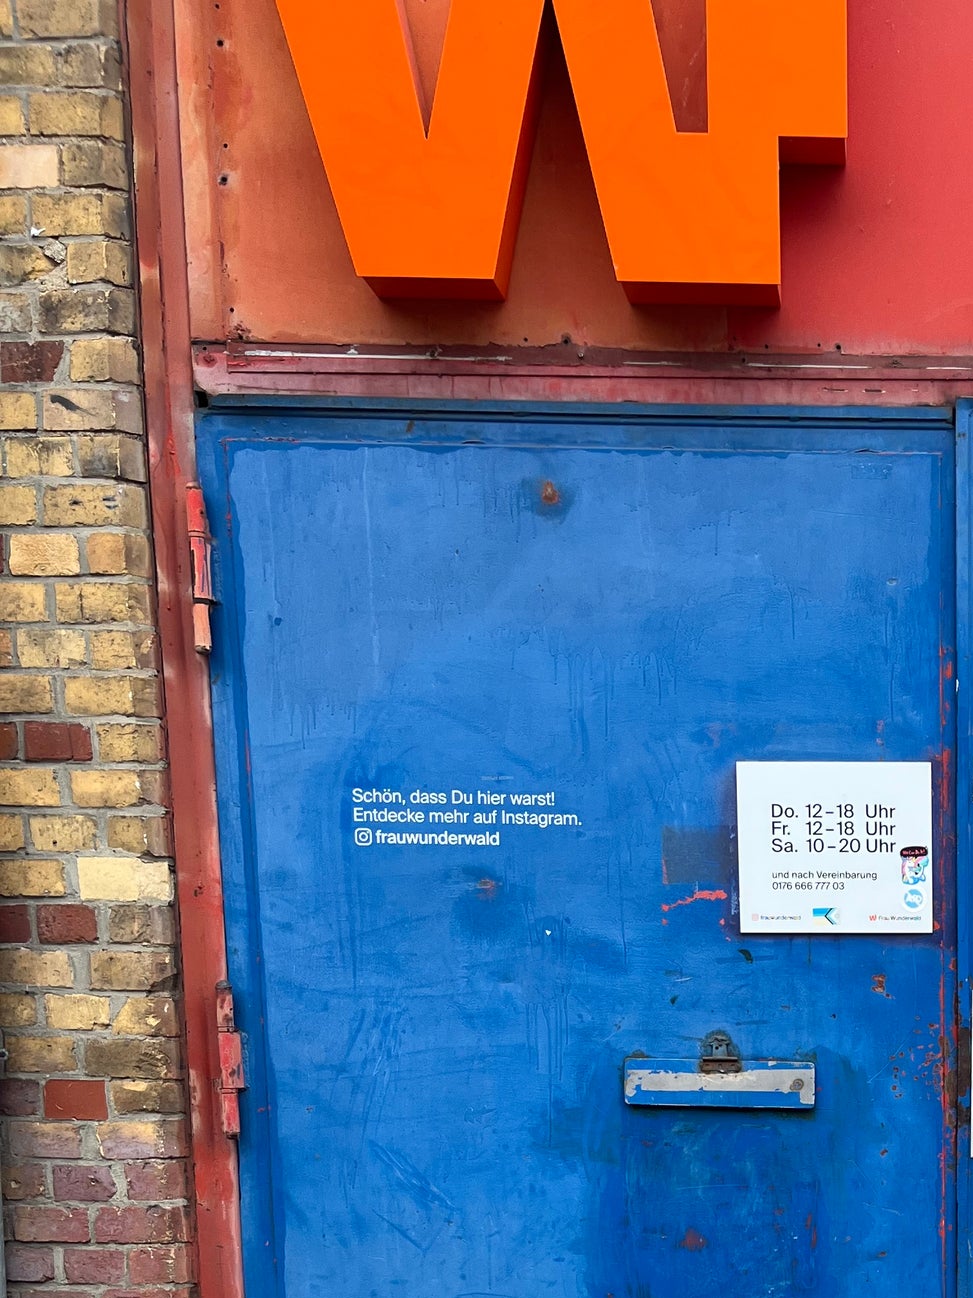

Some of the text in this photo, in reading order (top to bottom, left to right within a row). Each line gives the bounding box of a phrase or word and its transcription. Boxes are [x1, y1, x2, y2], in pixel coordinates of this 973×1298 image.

[352, 788, 555, 806] Schön, dass Du hier warst!
[353, 807, 582, 828] Entdecke mehr auf Instagram.
[771, 803, 799, 818] Do.
[865, 803, 896, 818] Uhr
[771, 820, 791, 835] Fr.
[865, 820, 896, 836] Uhr
[375, 829, 500, 846] frauwunderwald
[771, 838, 798, 853] Sa.
[866, 838, 896, 853] Uhr
[771, 870, 878, 881] und nach Vereinbarung
[771, 881, 845, 890] 0176 666 777 03
